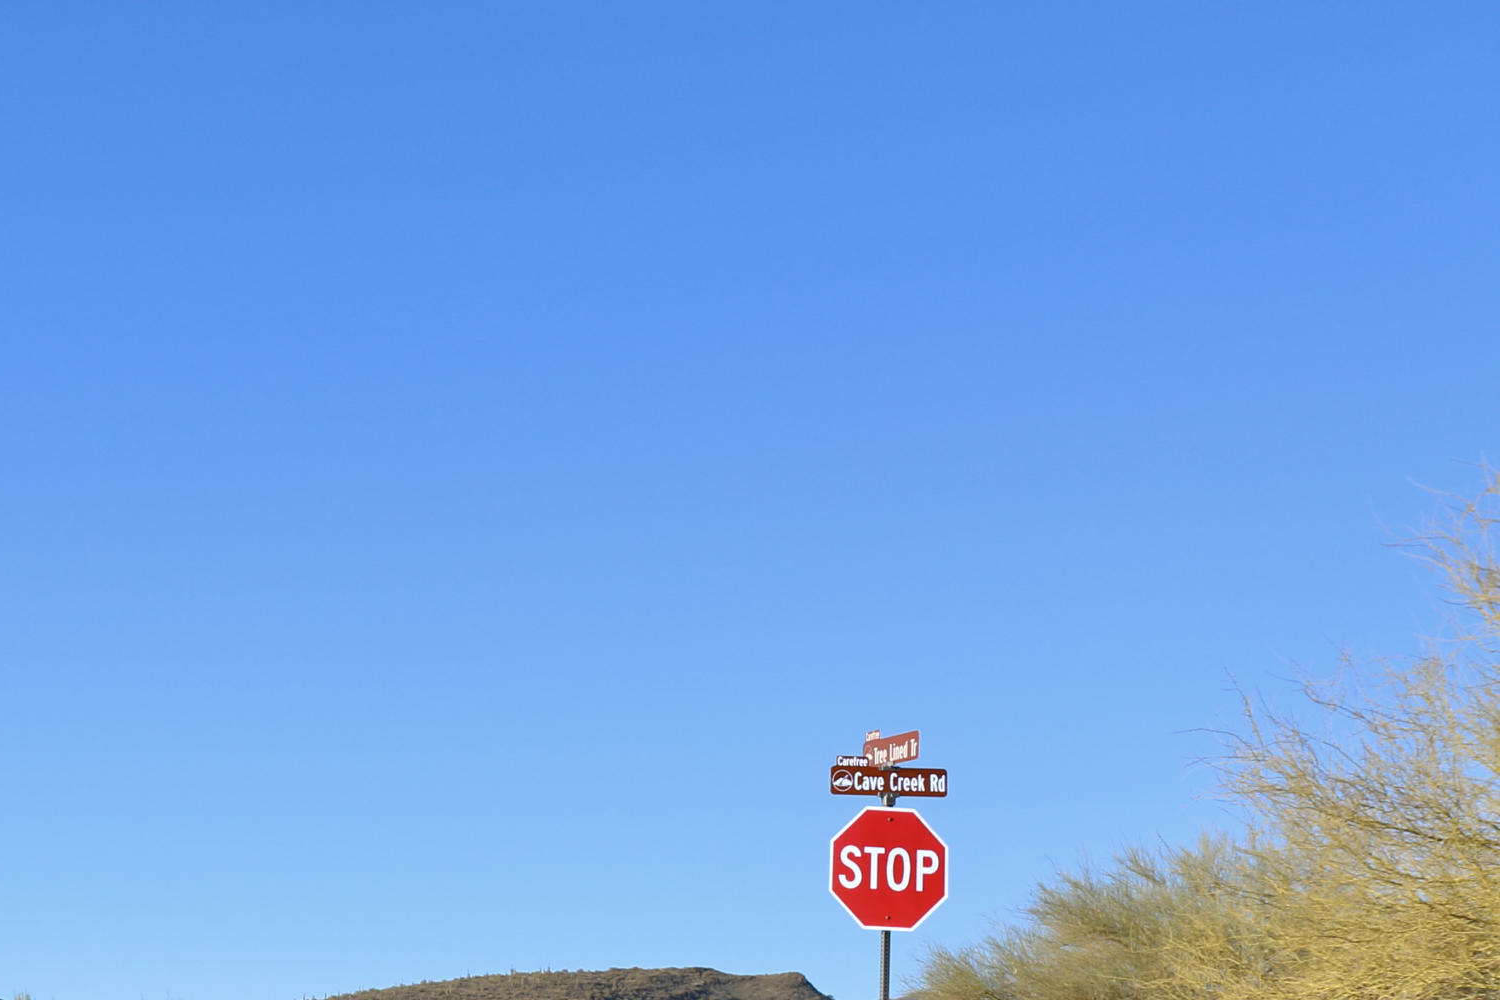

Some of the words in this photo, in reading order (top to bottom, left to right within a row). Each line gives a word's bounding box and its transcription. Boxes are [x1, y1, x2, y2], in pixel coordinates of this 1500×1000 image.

[837, 756, 869, 767] Carefree
[873, 746, 887, 765] Tree
[889, 740, 908, 761] Lined
[910, 738, 918, 757] Tr
[854, 771, 885, 791] Cave
[889, 772, 926, 792] Creek
[930, 774, 946, 793] Rd
[838, 844, 940, 893] STOP
